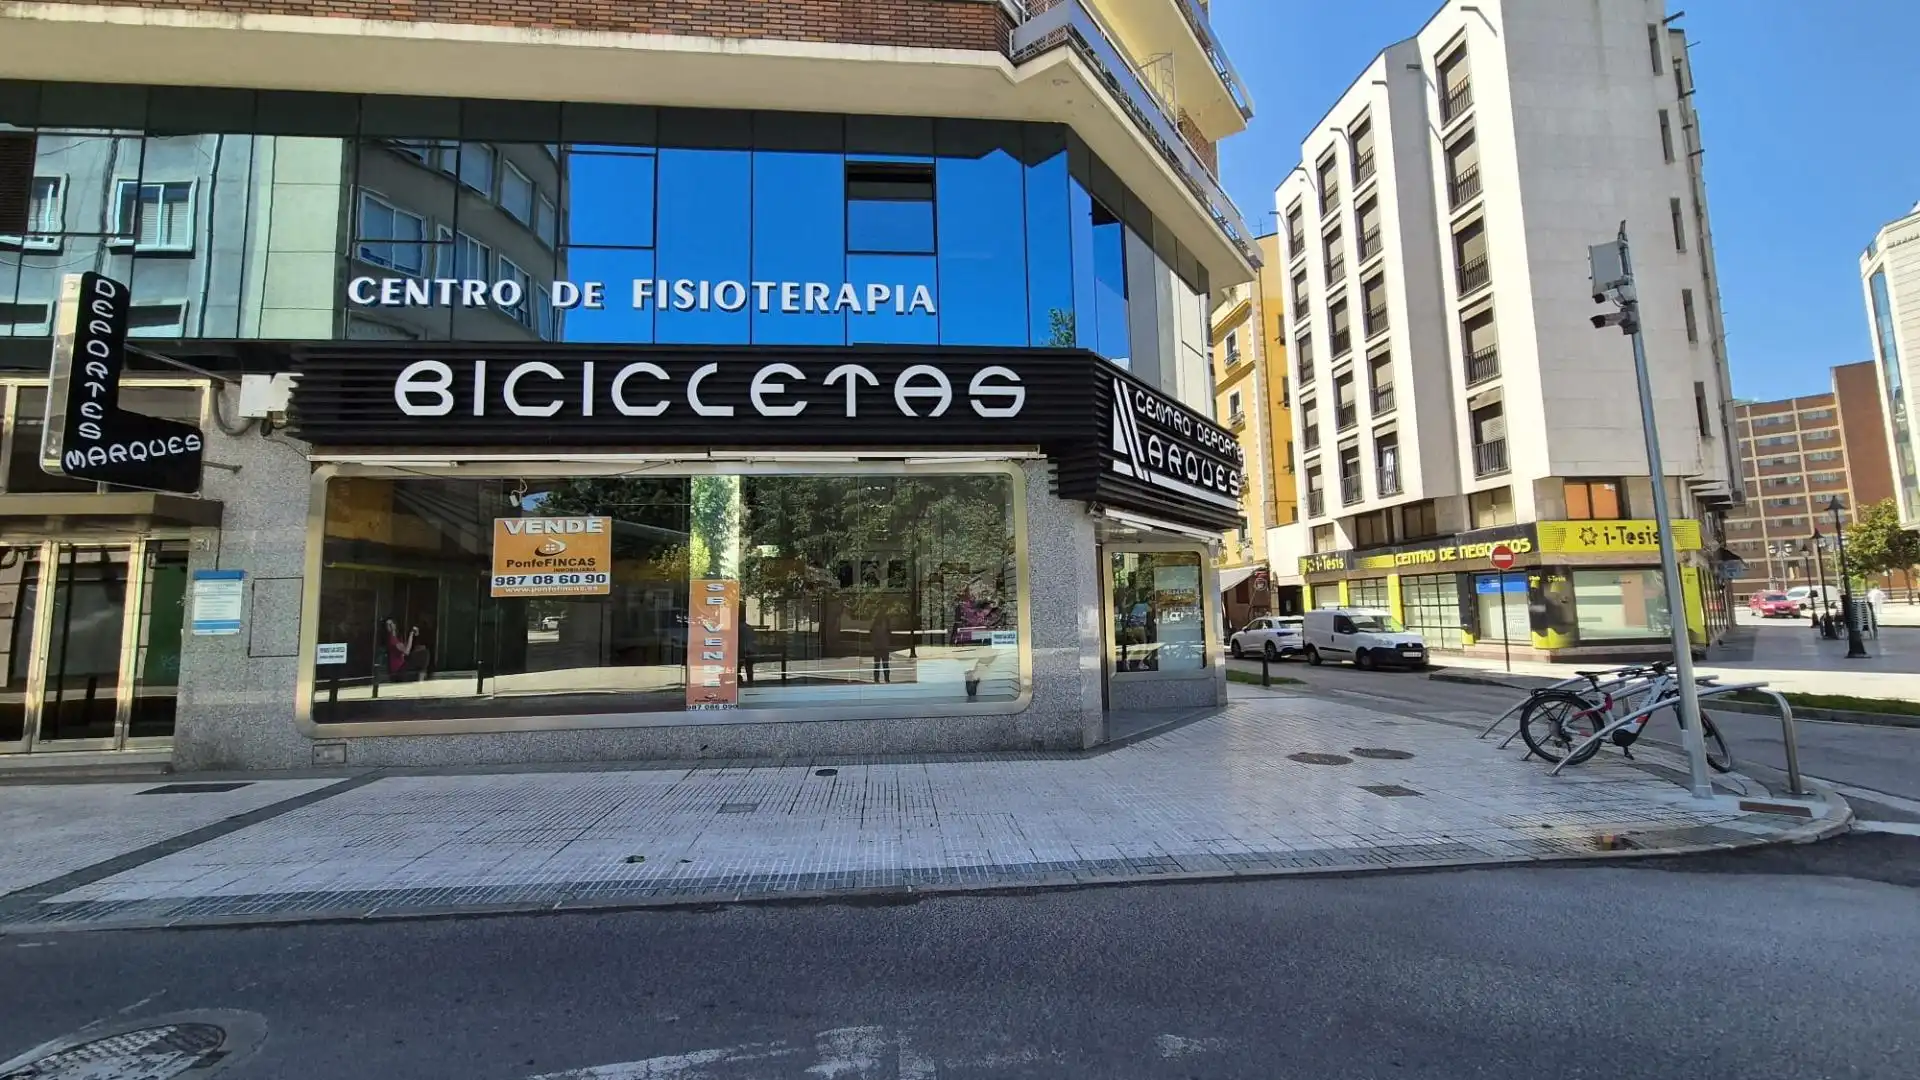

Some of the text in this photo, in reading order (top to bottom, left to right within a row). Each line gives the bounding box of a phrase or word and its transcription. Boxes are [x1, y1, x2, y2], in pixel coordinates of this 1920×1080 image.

[348, 276, 936, 314] CENTRO DE FISIOTERAPIA
[78, 278, 116, 440] DEPORTES
[394, 360, 1026, 418] BICICLETAS
[1135, 389, 1192, 437] CENTRO
[65, 433, 201, 470] MARQUES
[504, 518, 604, 535] VENDE
[1603, 525, 1660, 546] i-Tesis
[506, 557, 596, 568] PonfeFINCAS
[1394, 549, 1436, 567] CENTRO
[1439, 546, 1457, 562] DE
[495, 573, 606, 586] 987 08 60 90
